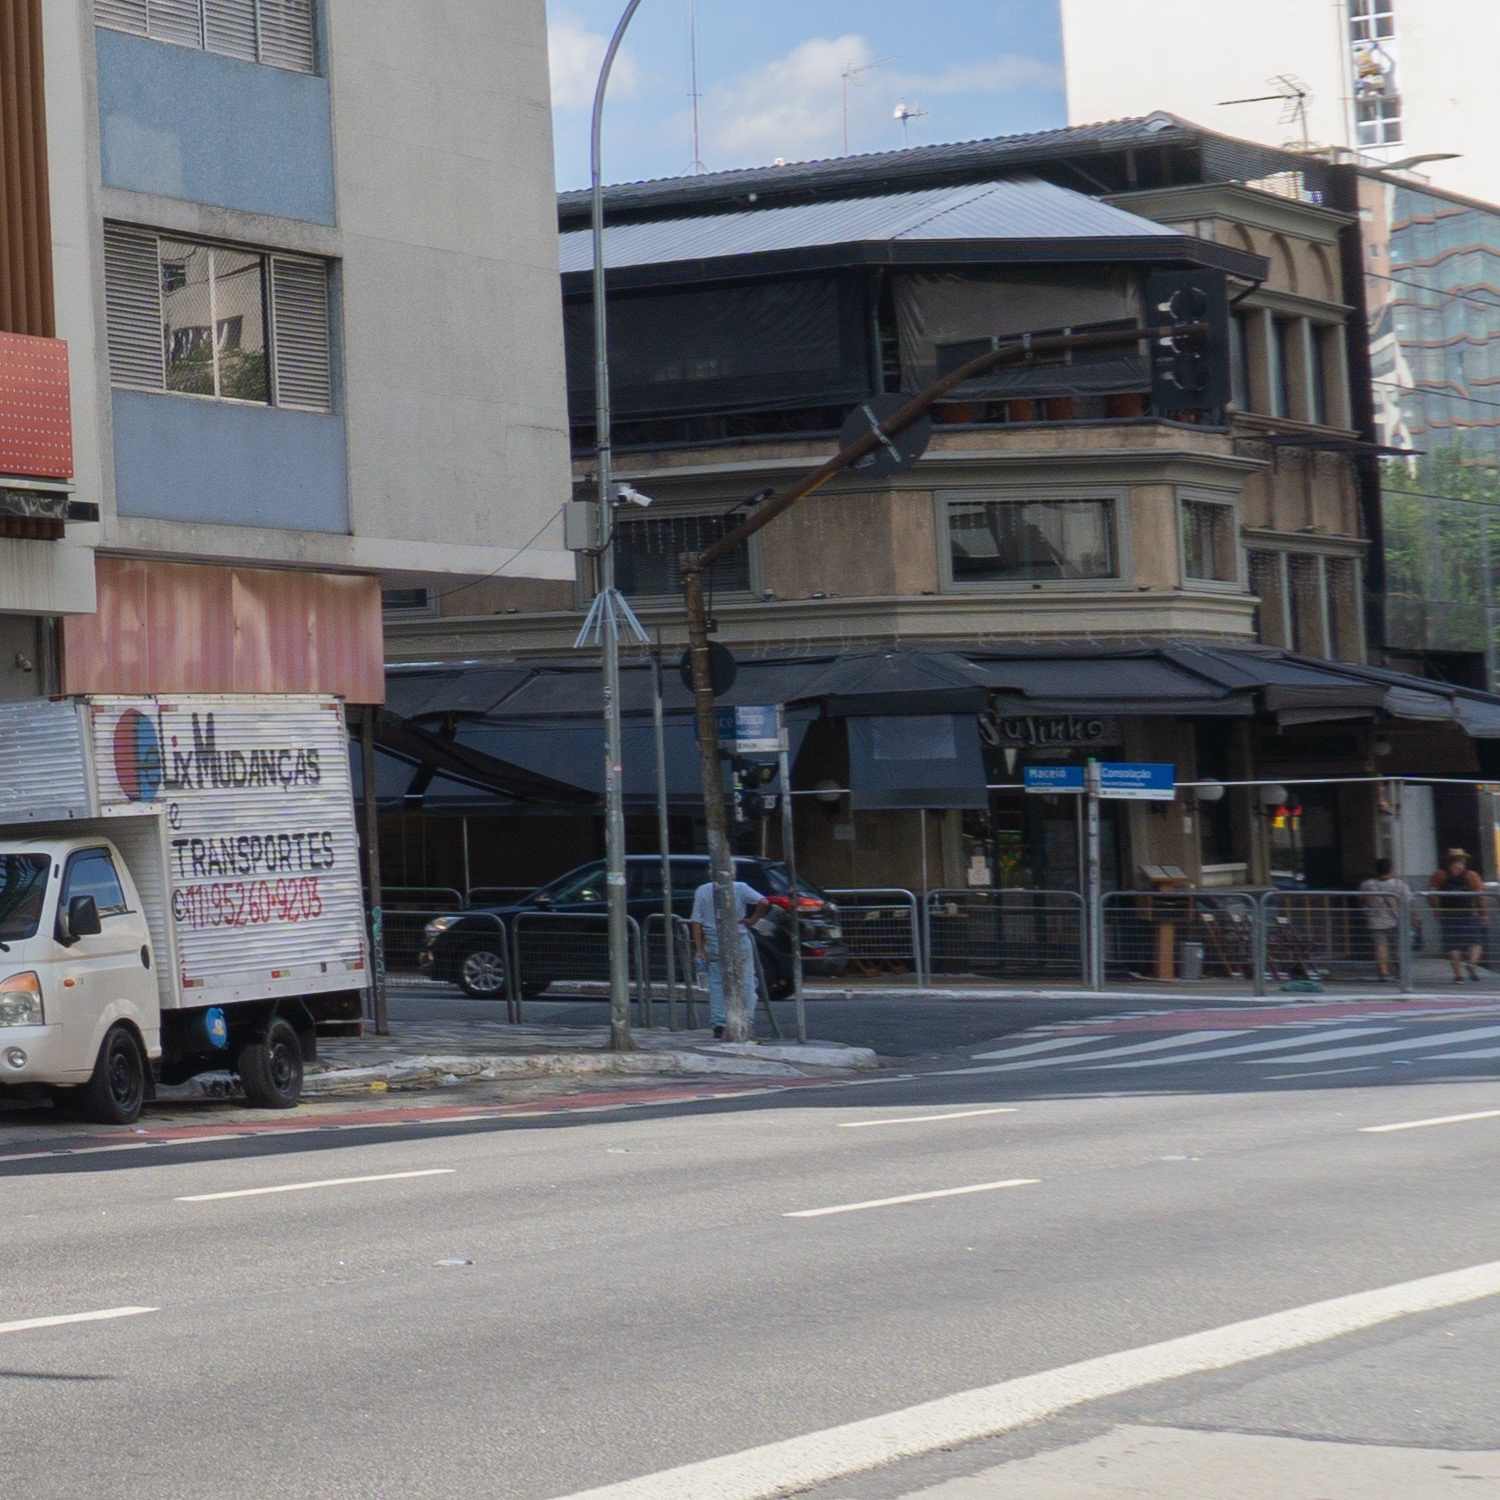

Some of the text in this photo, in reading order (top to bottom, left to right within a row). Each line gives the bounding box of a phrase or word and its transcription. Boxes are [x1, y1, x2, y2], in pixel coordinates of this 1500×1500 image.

[1102, 767, 1152, 781] Consolação
[169, 802, 182, 830] e
[172, 831, 335, 878] TRANSPORTES
